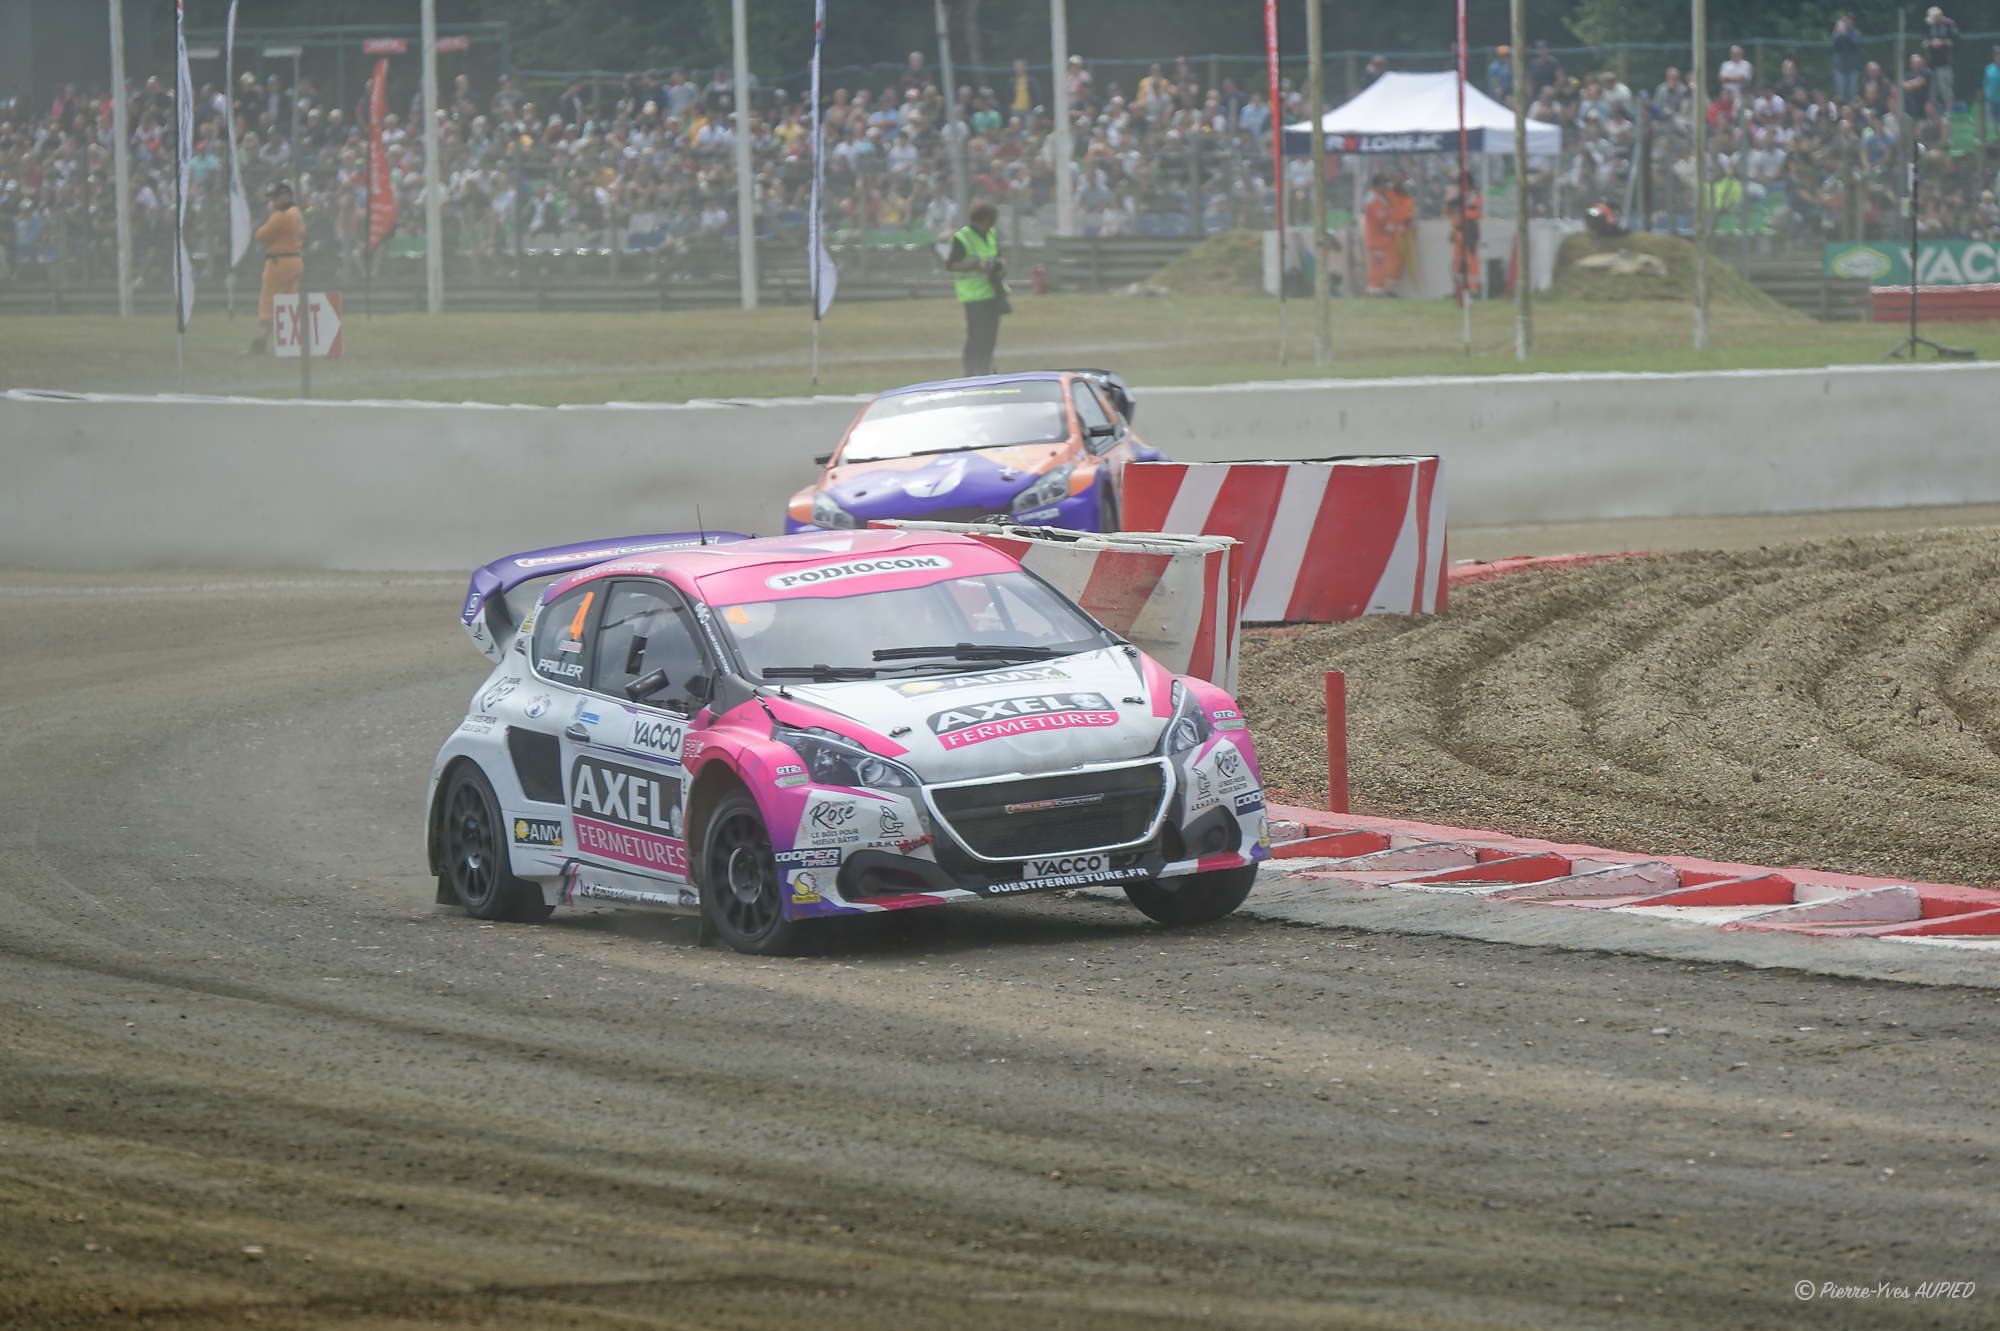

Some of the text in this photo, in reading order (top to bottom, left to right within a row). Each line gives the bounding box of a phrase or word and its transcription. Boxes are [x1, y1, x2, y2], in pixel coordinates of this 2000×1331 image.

[1899, 242, 2000, 283] YAC
[275, 304, 320, 346] EXT
[780, 558, 939, 587] PODIOCOM
[936, 696, 1078, 733] AXEL
[947, 712, 1115, 747] FERMETURES
[634, 720, 681, 753] YACCO
[572, 763, 671, 831] AXEL
[530, 823, 561, 841] AMY
[809, 801, 856, 830] Rose
[578, 823, 687, 869] FERMETURES
[775, 849, 839, 862] COOPER
[988, 867, 1149, 894] OUESTFERMETURE.FR
[1032, 856, 1102, 876] YACCO
